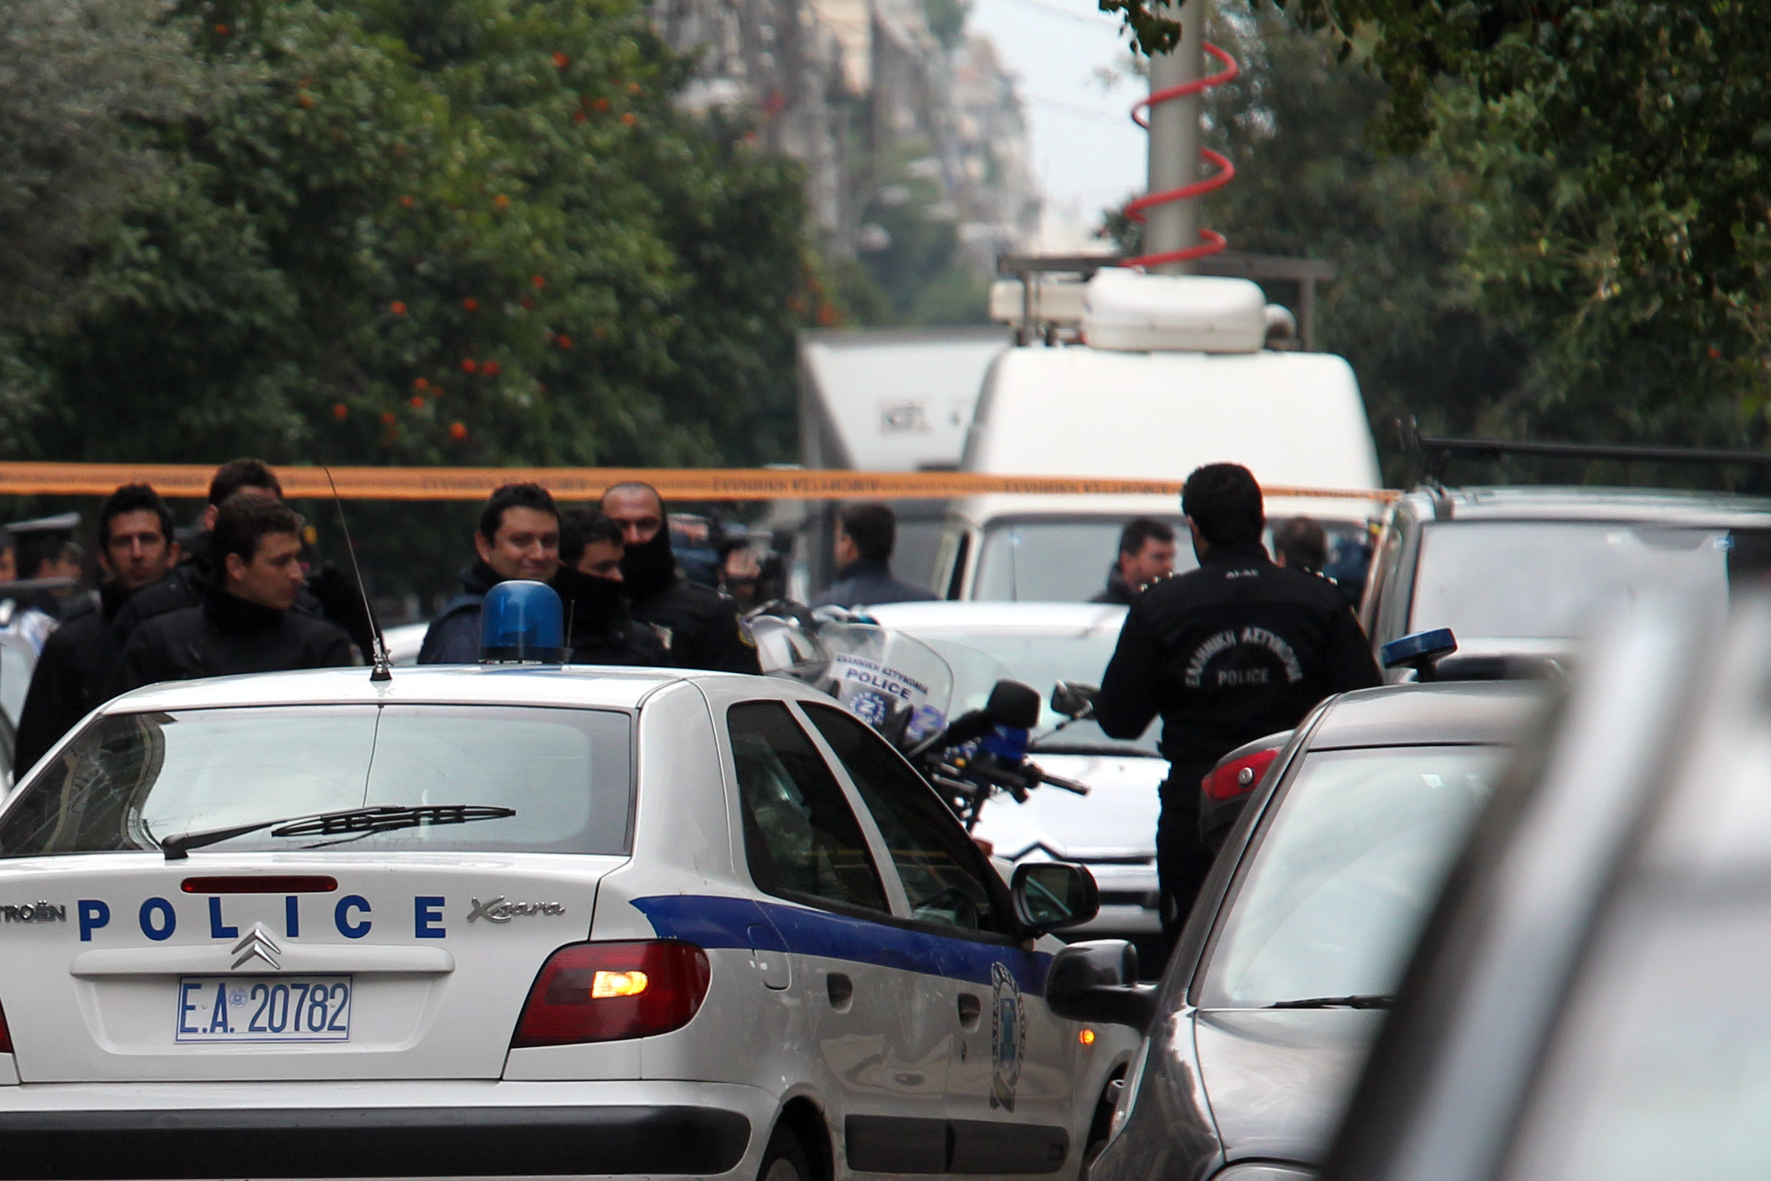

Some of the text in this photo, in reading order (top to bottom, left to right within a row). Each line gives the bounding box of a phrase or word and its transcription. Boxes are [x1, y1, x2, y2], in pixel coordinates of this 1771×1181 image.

[846, 667, 912, 700] POLICE
[1217, 668, 1269, 686] POLICE
[77, 895, 447, 942] POLICE
[466, 894, 567, 924] Xsara
[248, 982, 350, 1033] 20782
